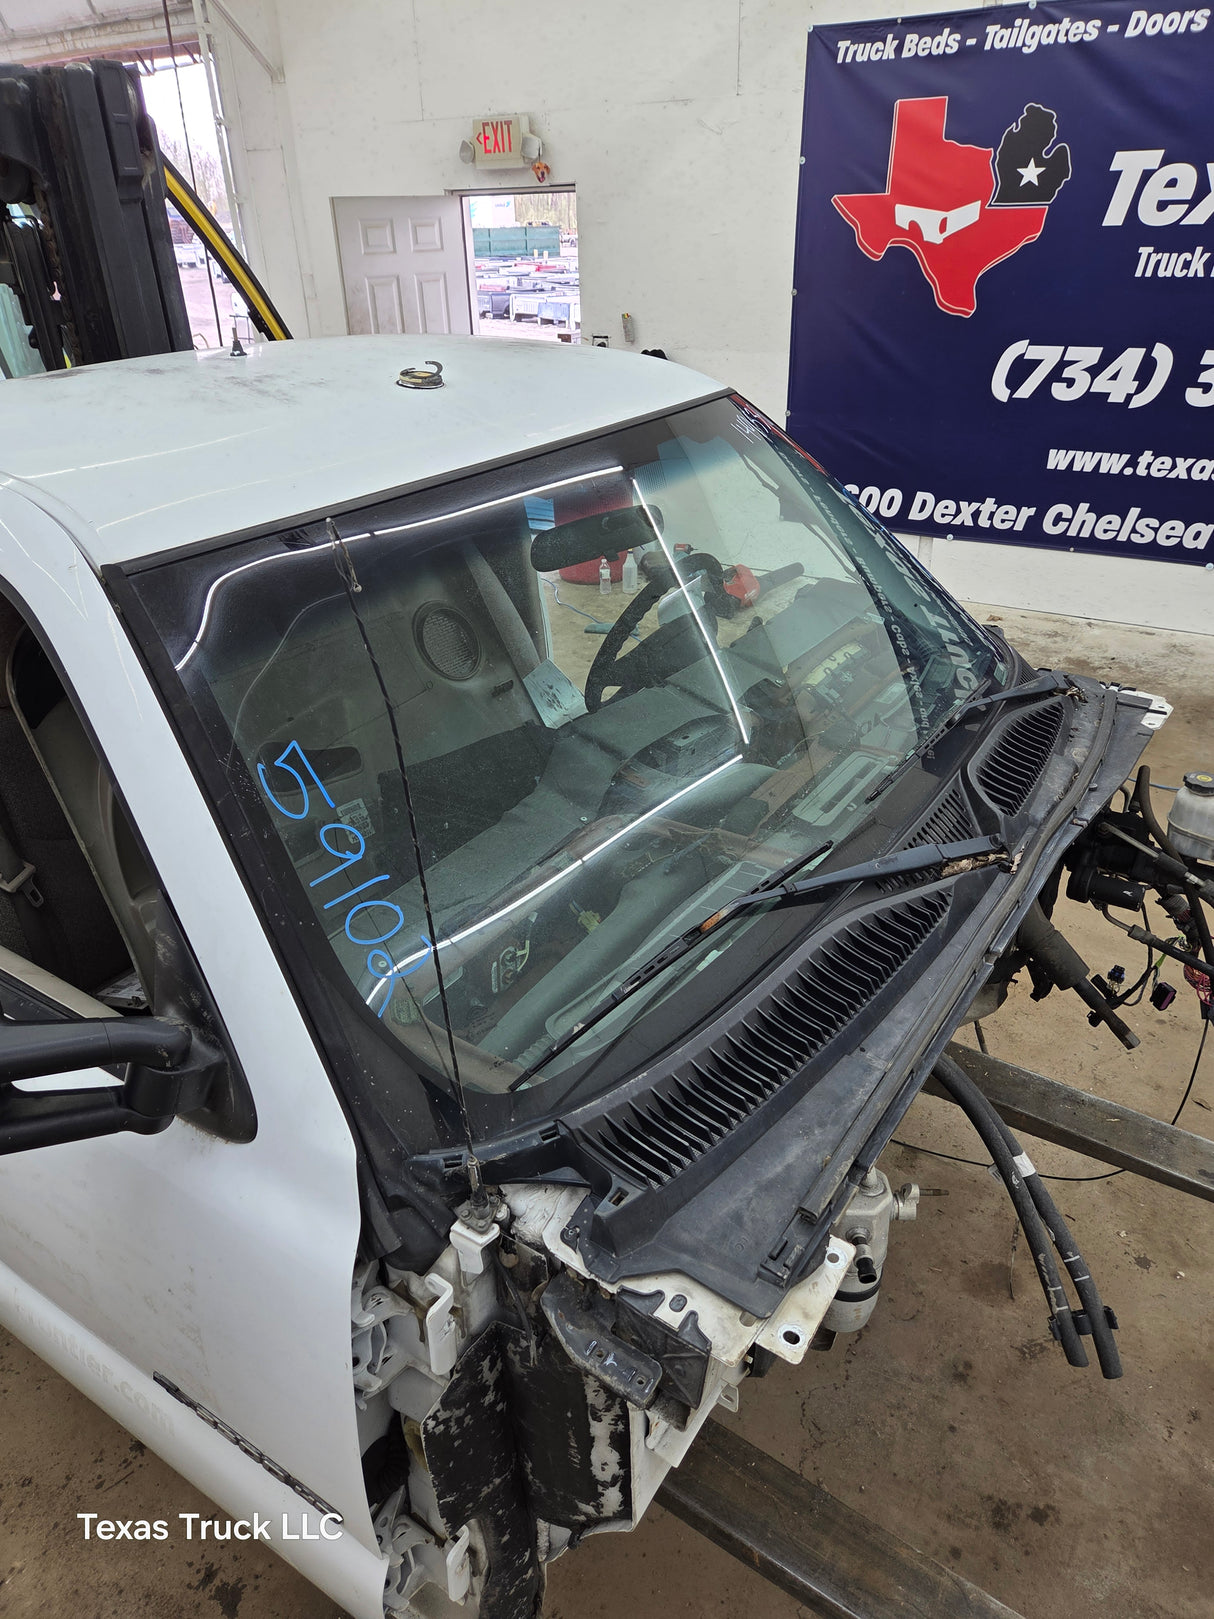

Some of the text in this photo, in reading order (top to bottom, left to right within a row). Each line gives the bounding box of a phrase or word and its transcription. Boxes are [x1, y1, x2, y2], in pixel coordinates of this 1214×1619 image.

[836, 34, 898, 64] Truck
[901, 28, 960, 58] Beds
[983, 17, 1102, 54] Tailgates
[1124, 8, 1211, 38] Doors
[482, 119, 513, 154] EXIT
[1134, 246, 1211, 278] Truck
[991, 339, 1174, 409] (734)
[1046, 448, 1214, 481] www.texa
[908, 491, 1036, 531] Dexter
[1042, 503, 1214, 550] Chelsea
